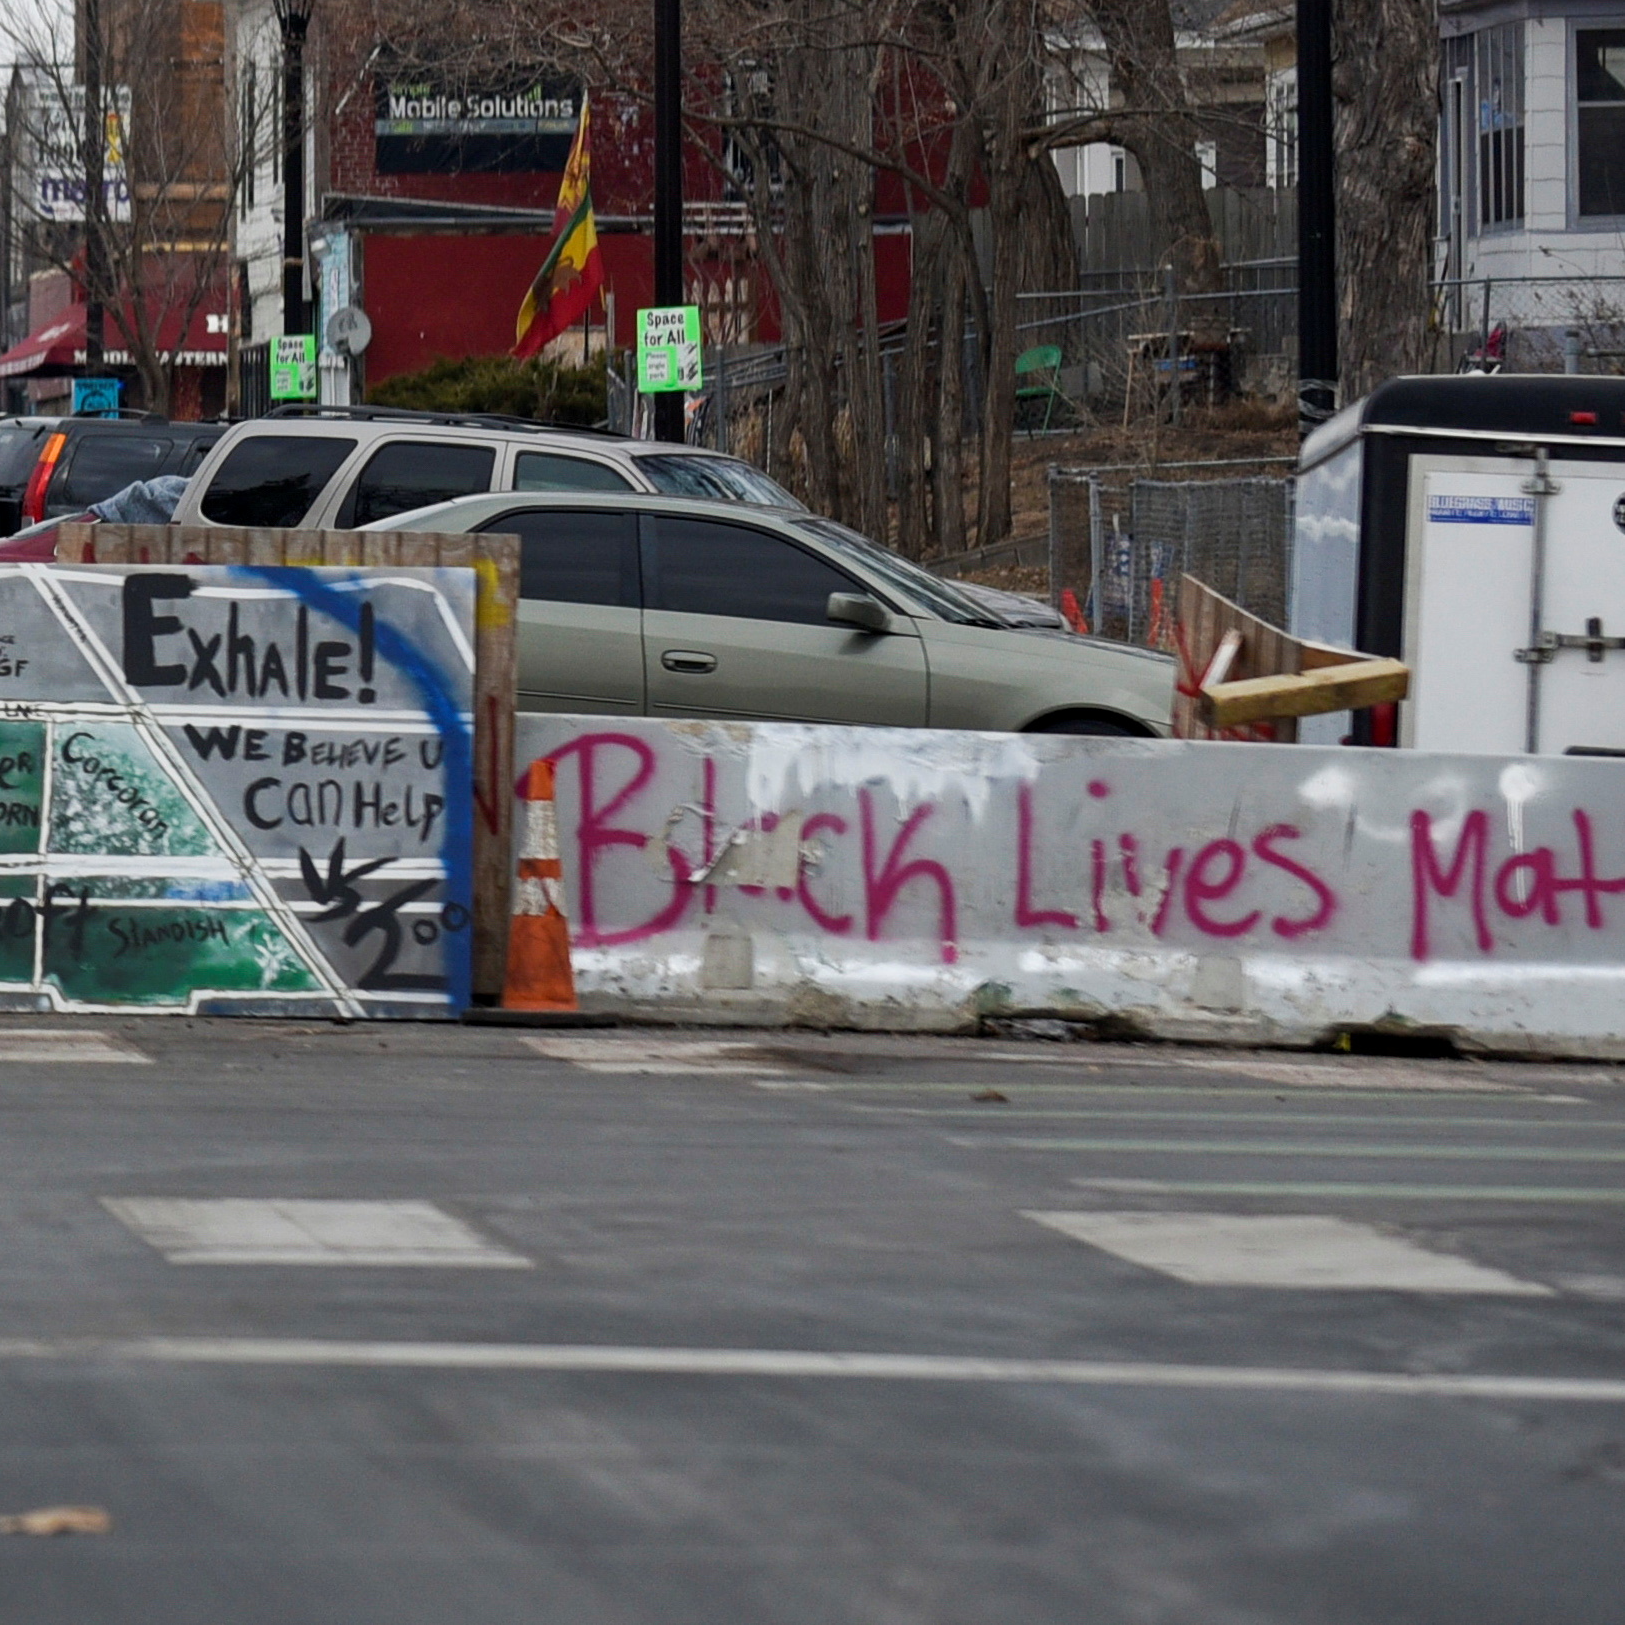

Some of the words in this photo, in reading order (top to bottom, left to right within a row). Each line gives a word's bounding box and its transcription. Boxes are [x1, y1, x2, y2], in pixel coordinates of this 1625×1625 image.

[389, 94, 461, 120] Mobile
[466, 94, 573, 119] Solutions
[647, 312, 684, 330] Space
[644, 331, 663, 347] for
[667, 329, 685, 345] All
[292, 352, 305, 363] All
[184, 722, 272, 762] WE
[61, 731, 169, 842] Corcoran
[1017, 779, 1339, 939] Lives
